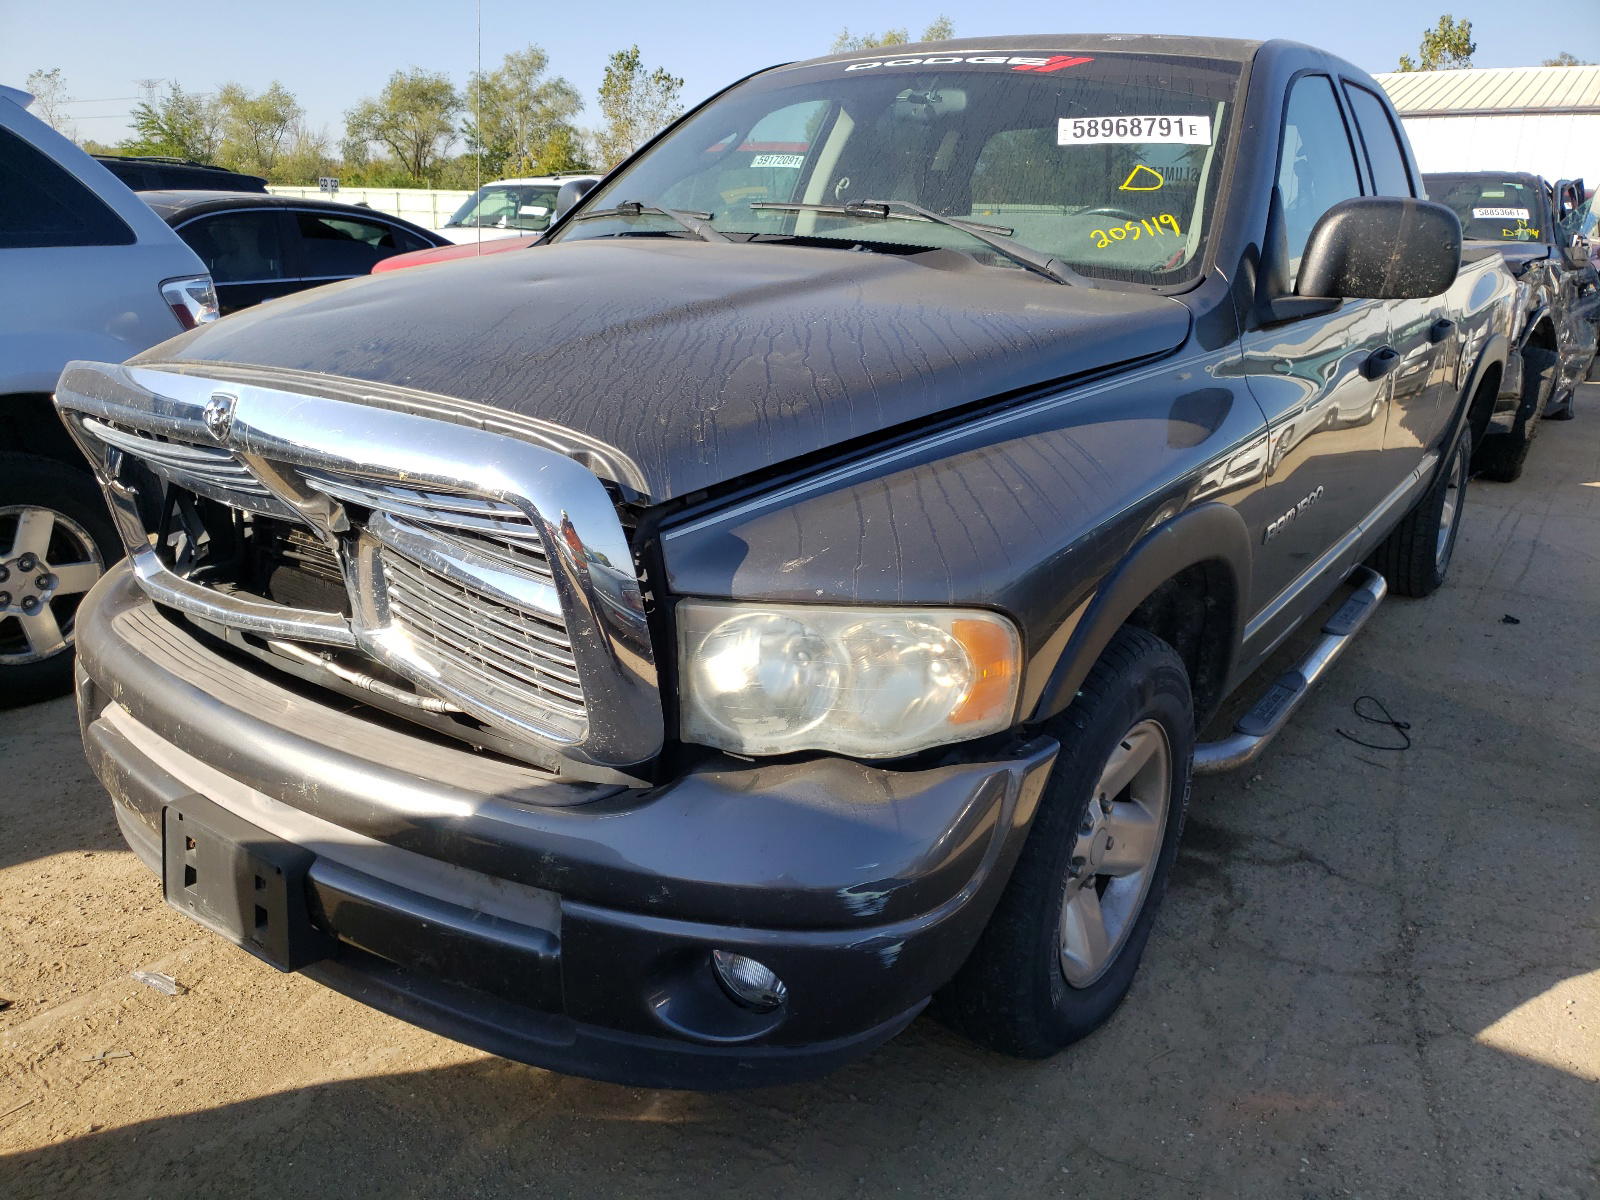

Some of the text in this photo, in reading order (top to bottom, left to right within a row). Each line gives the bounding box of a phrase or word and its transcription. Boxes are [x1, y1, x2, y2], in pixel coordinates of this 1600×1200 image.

[844, 56, 1050, 72] DODGE
[1072, 118, 1198, 139] 58968791 E
[1089, 213, 1181, 248] 205119
